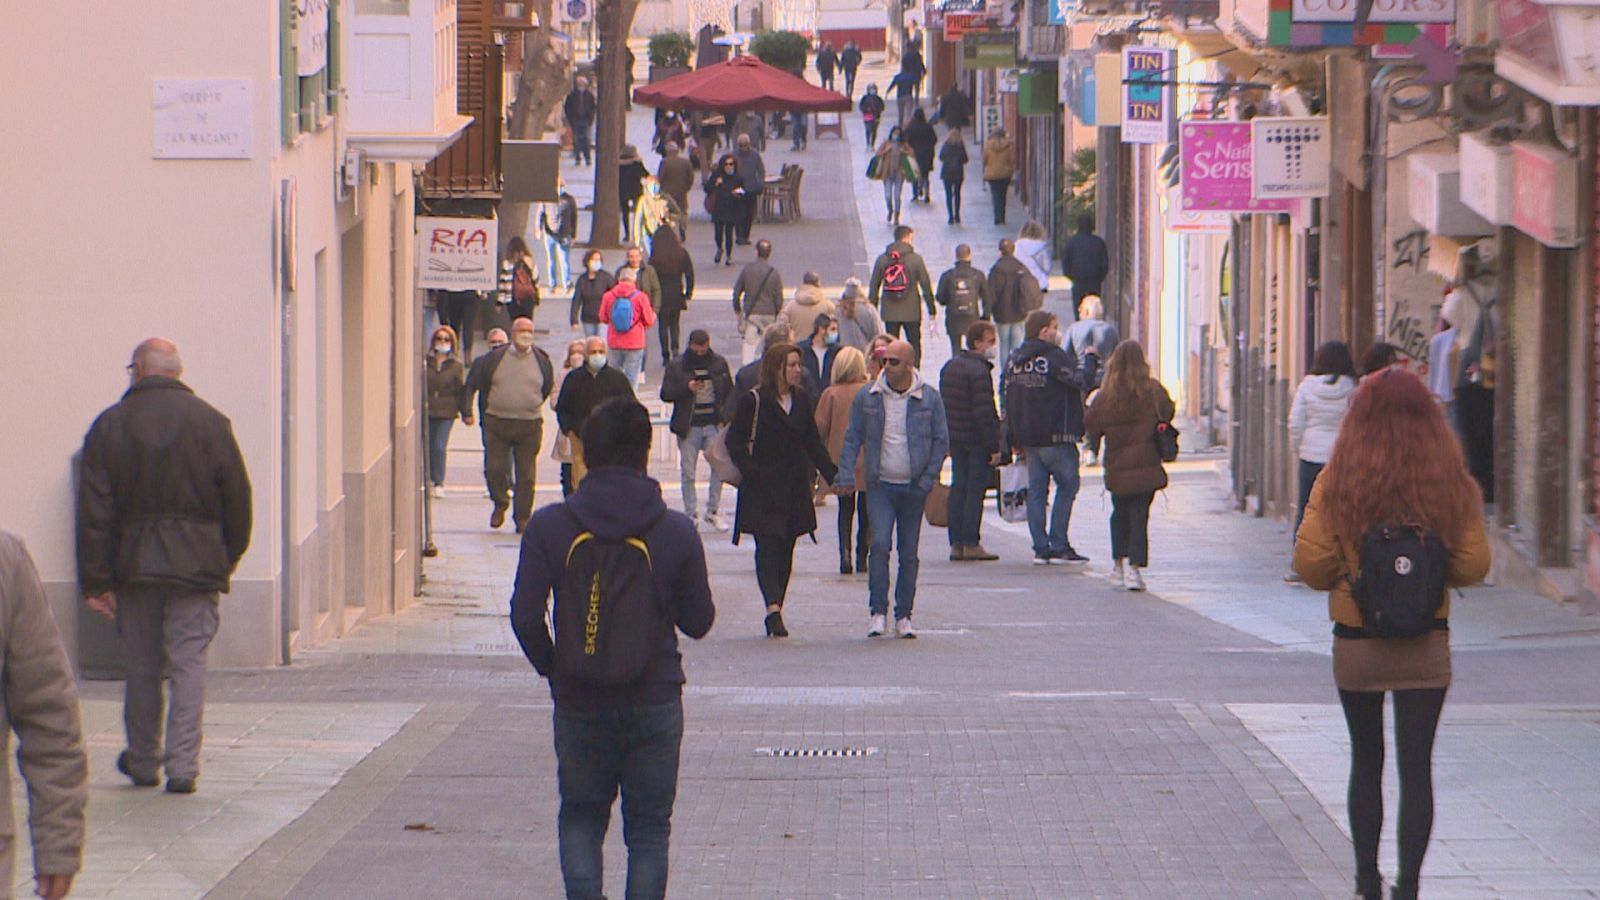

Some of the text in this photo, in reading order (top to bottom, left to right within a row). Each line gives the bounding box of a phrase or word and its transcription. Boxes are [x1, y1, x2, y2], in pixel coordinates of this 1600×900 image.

[1131, 54, 1160, 71] TIN
[1131, 104, 1159, 119] TIN
[431, 228, 488, 248] RIA
[584, 570, 601, 655] SKECHERS
